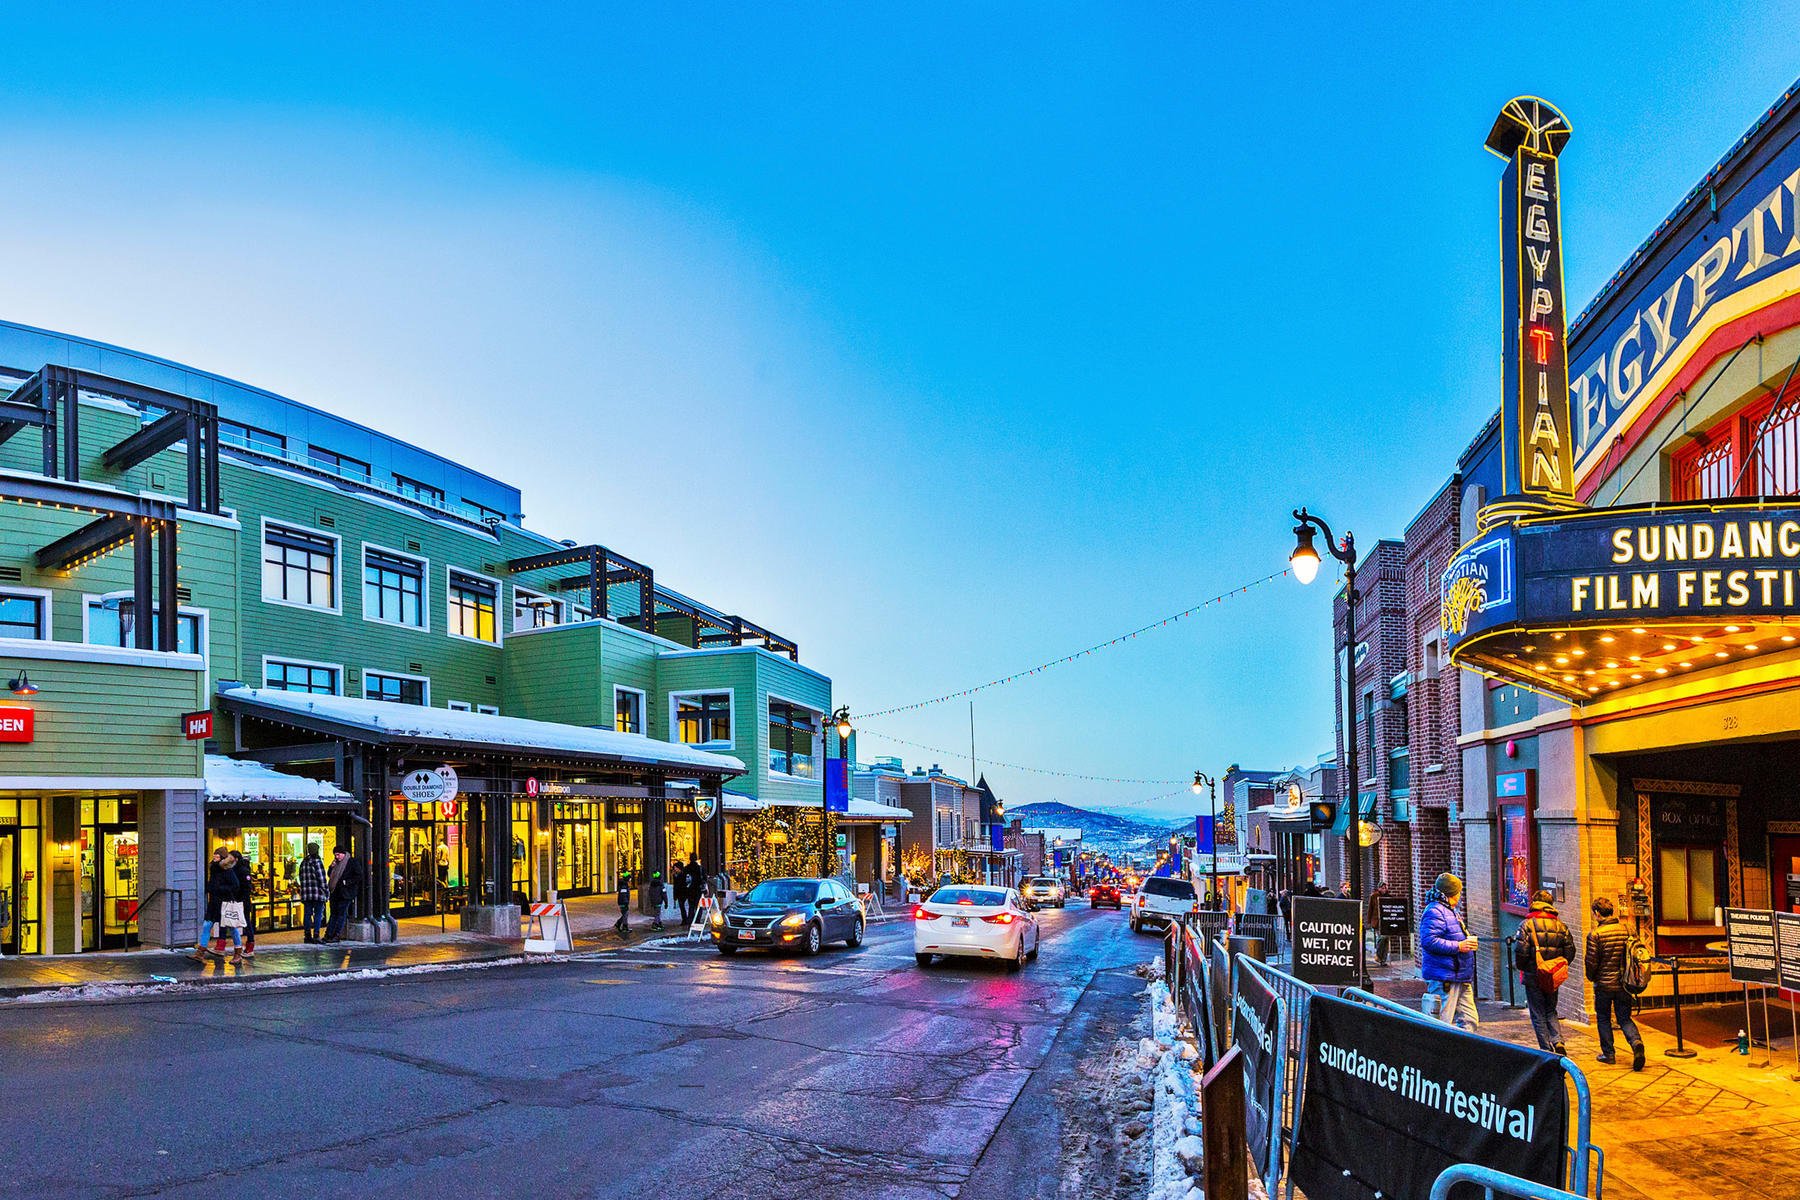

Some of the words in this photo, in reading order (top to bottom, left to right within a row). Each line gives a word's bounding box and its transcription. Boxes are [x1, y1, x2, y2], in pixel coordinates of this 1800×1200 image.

[1523, 161, 1563, 489] EGYPTIAN
[1571, 572, 1659, 612] FILM
[1677, 569, 1800, 608] FESTI
[189, 719, 207, 735] HH
[539, 782, 571, 794] lululemon
[1661, 811, 1682, 824] BOX
[1688, 814, 1720, 826] OFFICE
[1299, 921, 1355, 935] CAUTION:
[1302, 937, 1330, 951] WET,
[1334, 939, 1353, 951] ICY
[1300, 953, 1354, 967] SURFACE
[1319, 1041, 1398, 1092] sundance
[1401, 1065, 1441, 1109] film
[1445, 1080, 1535, 1143] festival
